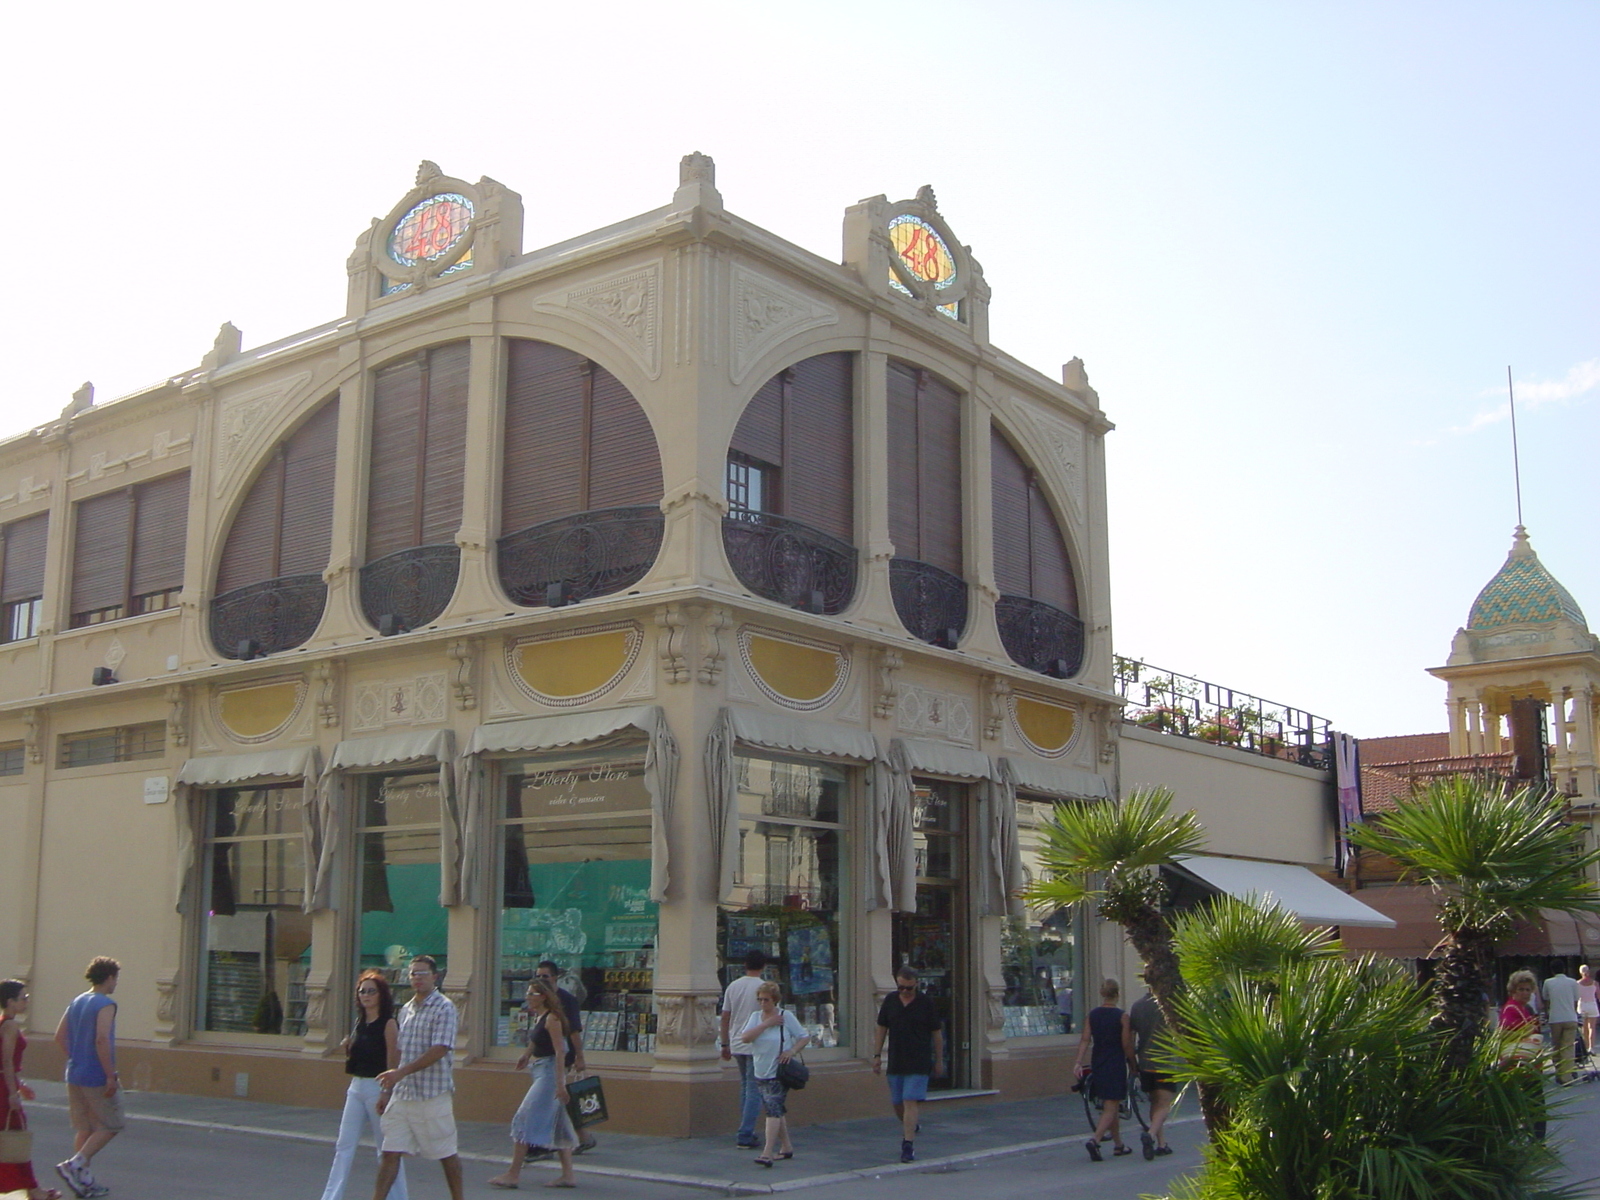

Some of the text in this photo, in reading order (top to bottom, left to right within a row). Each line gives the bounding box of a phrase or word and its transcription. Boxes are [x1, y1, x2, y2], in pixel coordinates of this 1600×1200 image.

[406, 202, 452, 257] 48
[901, 229, 940, 282] 48
[527, 762, 629, 793] Liberty Store
